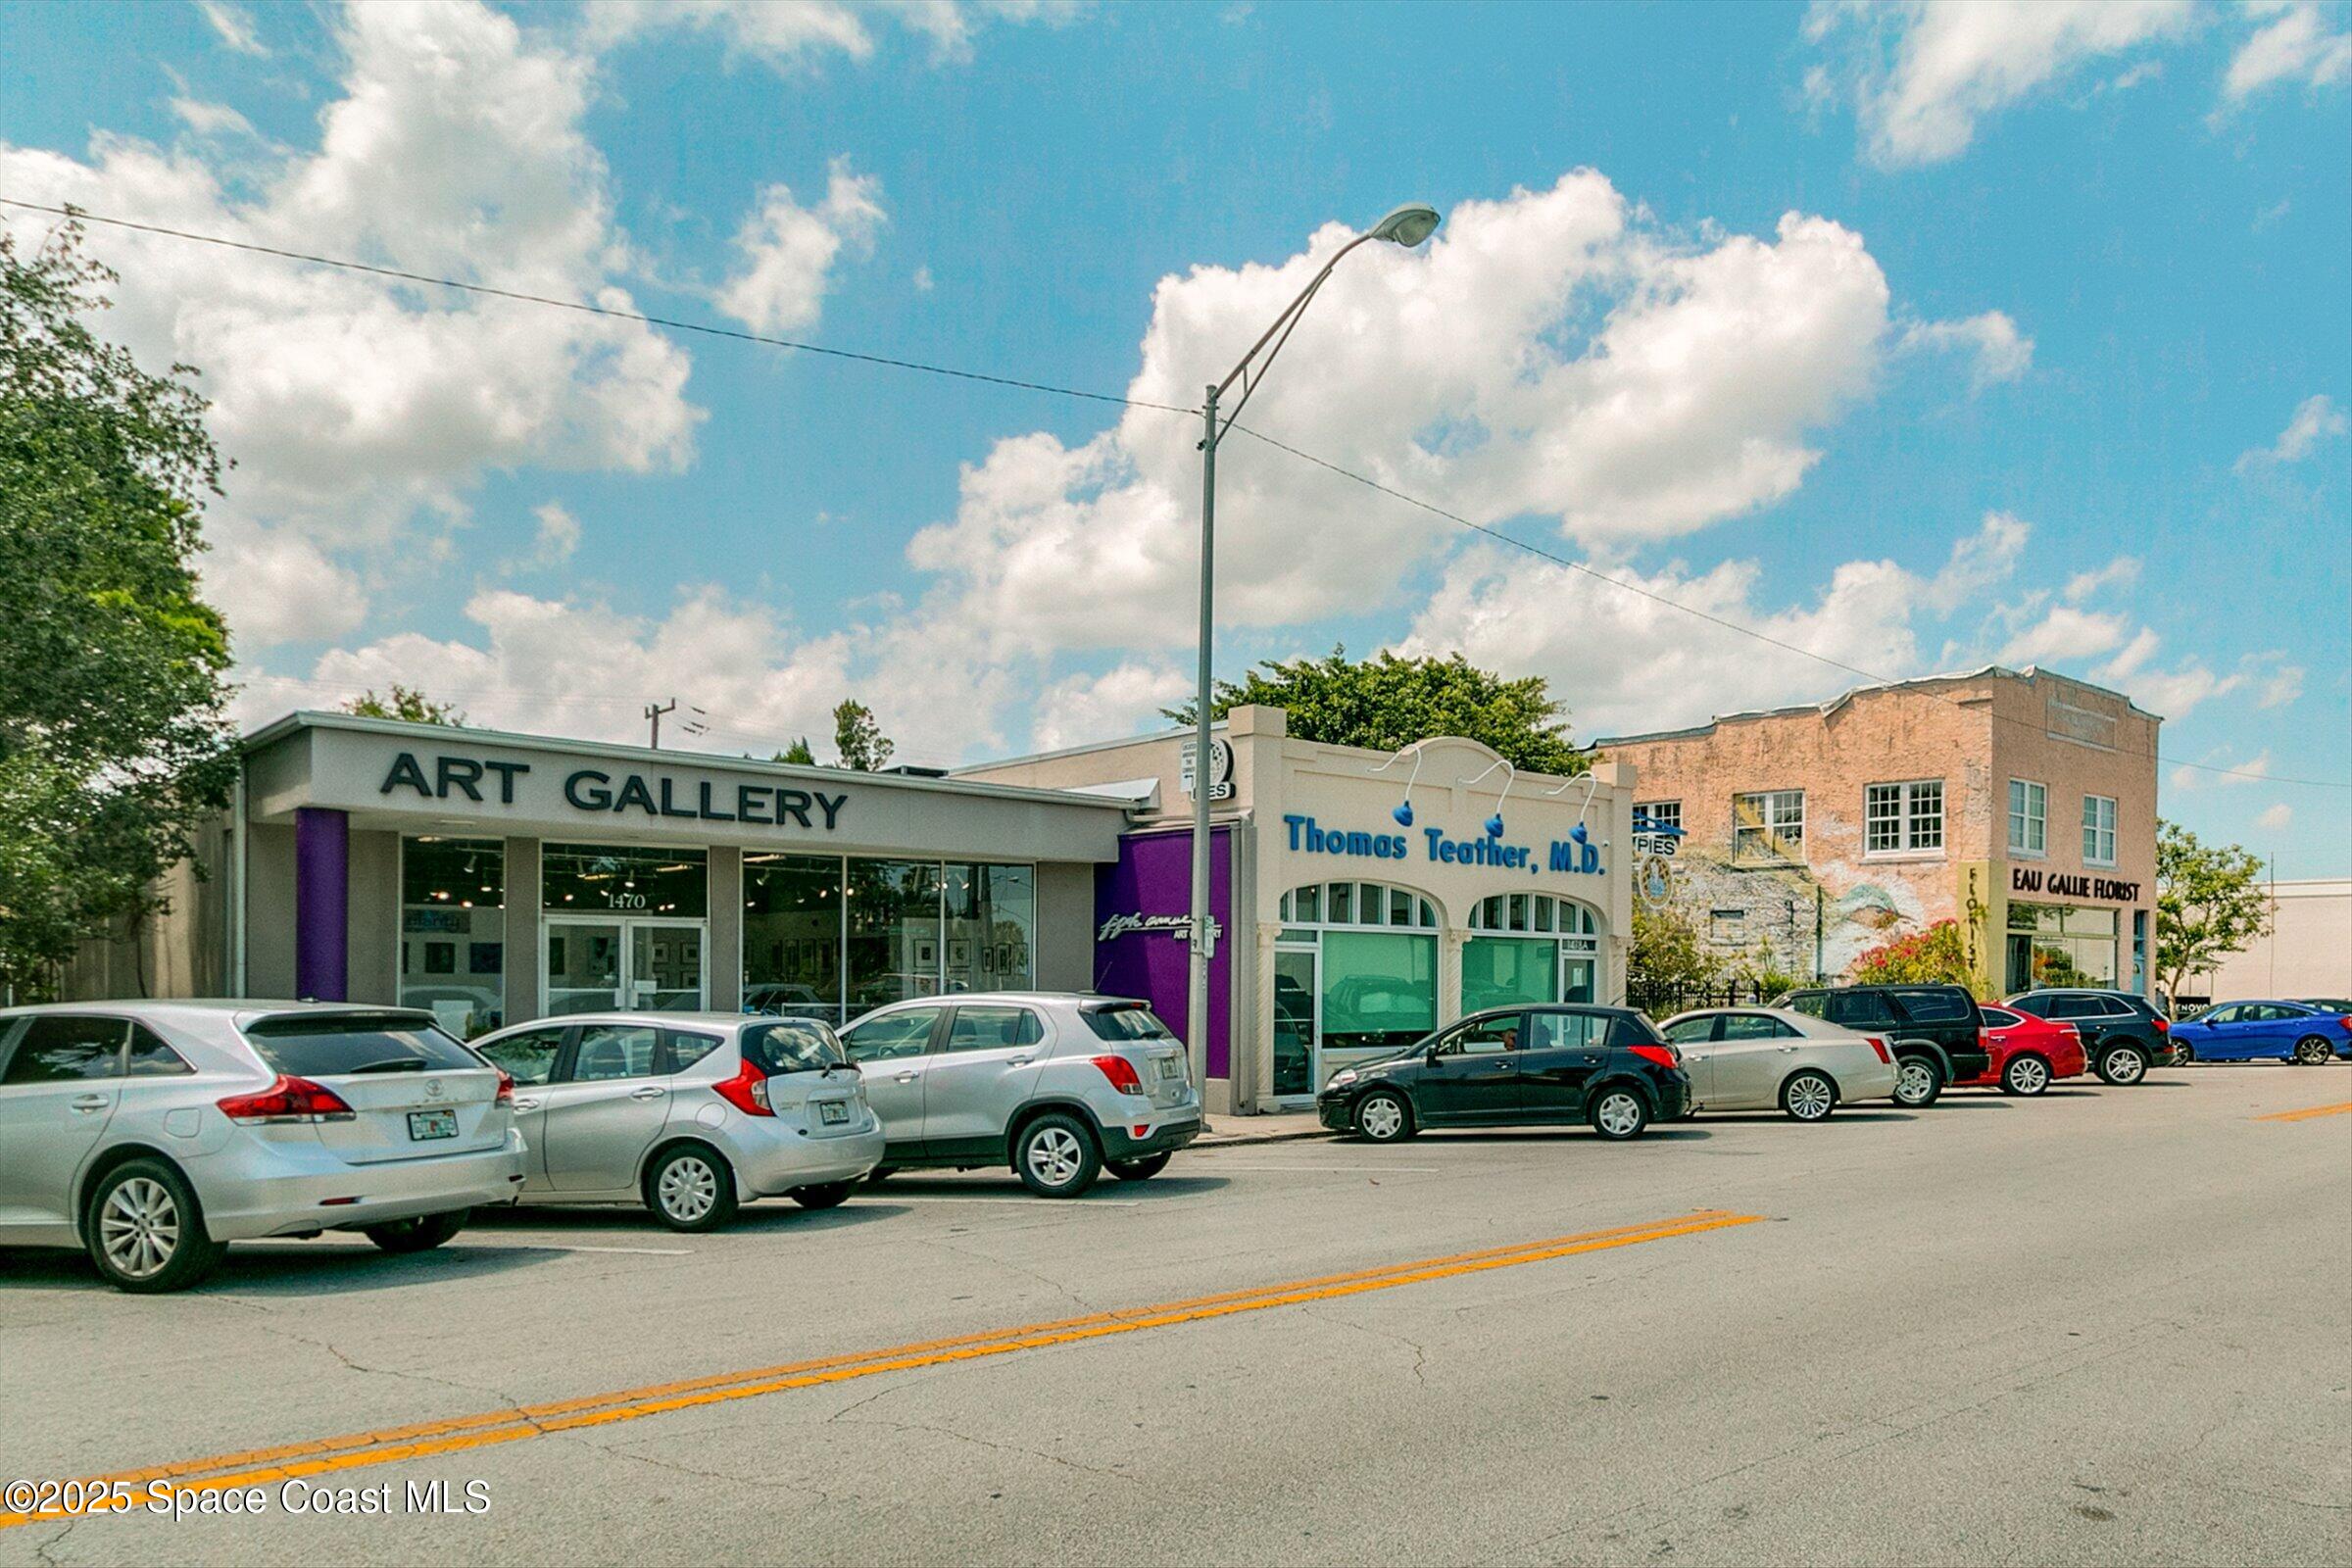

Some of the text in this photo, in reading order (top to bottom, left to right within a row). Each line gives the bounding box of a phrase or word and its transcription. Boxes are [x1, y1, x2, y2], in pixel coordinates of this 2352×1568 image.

[379, 752, 849, 829] ART GALLERY
[1284, 814, 1605, 875] Thomas Teather, M.D.
[1638, 839, 1676, 856] PIES
[609, 893, 646, 908] 1470
[2013, 868, 2141, 902] EAU GALLIE FLORIST
